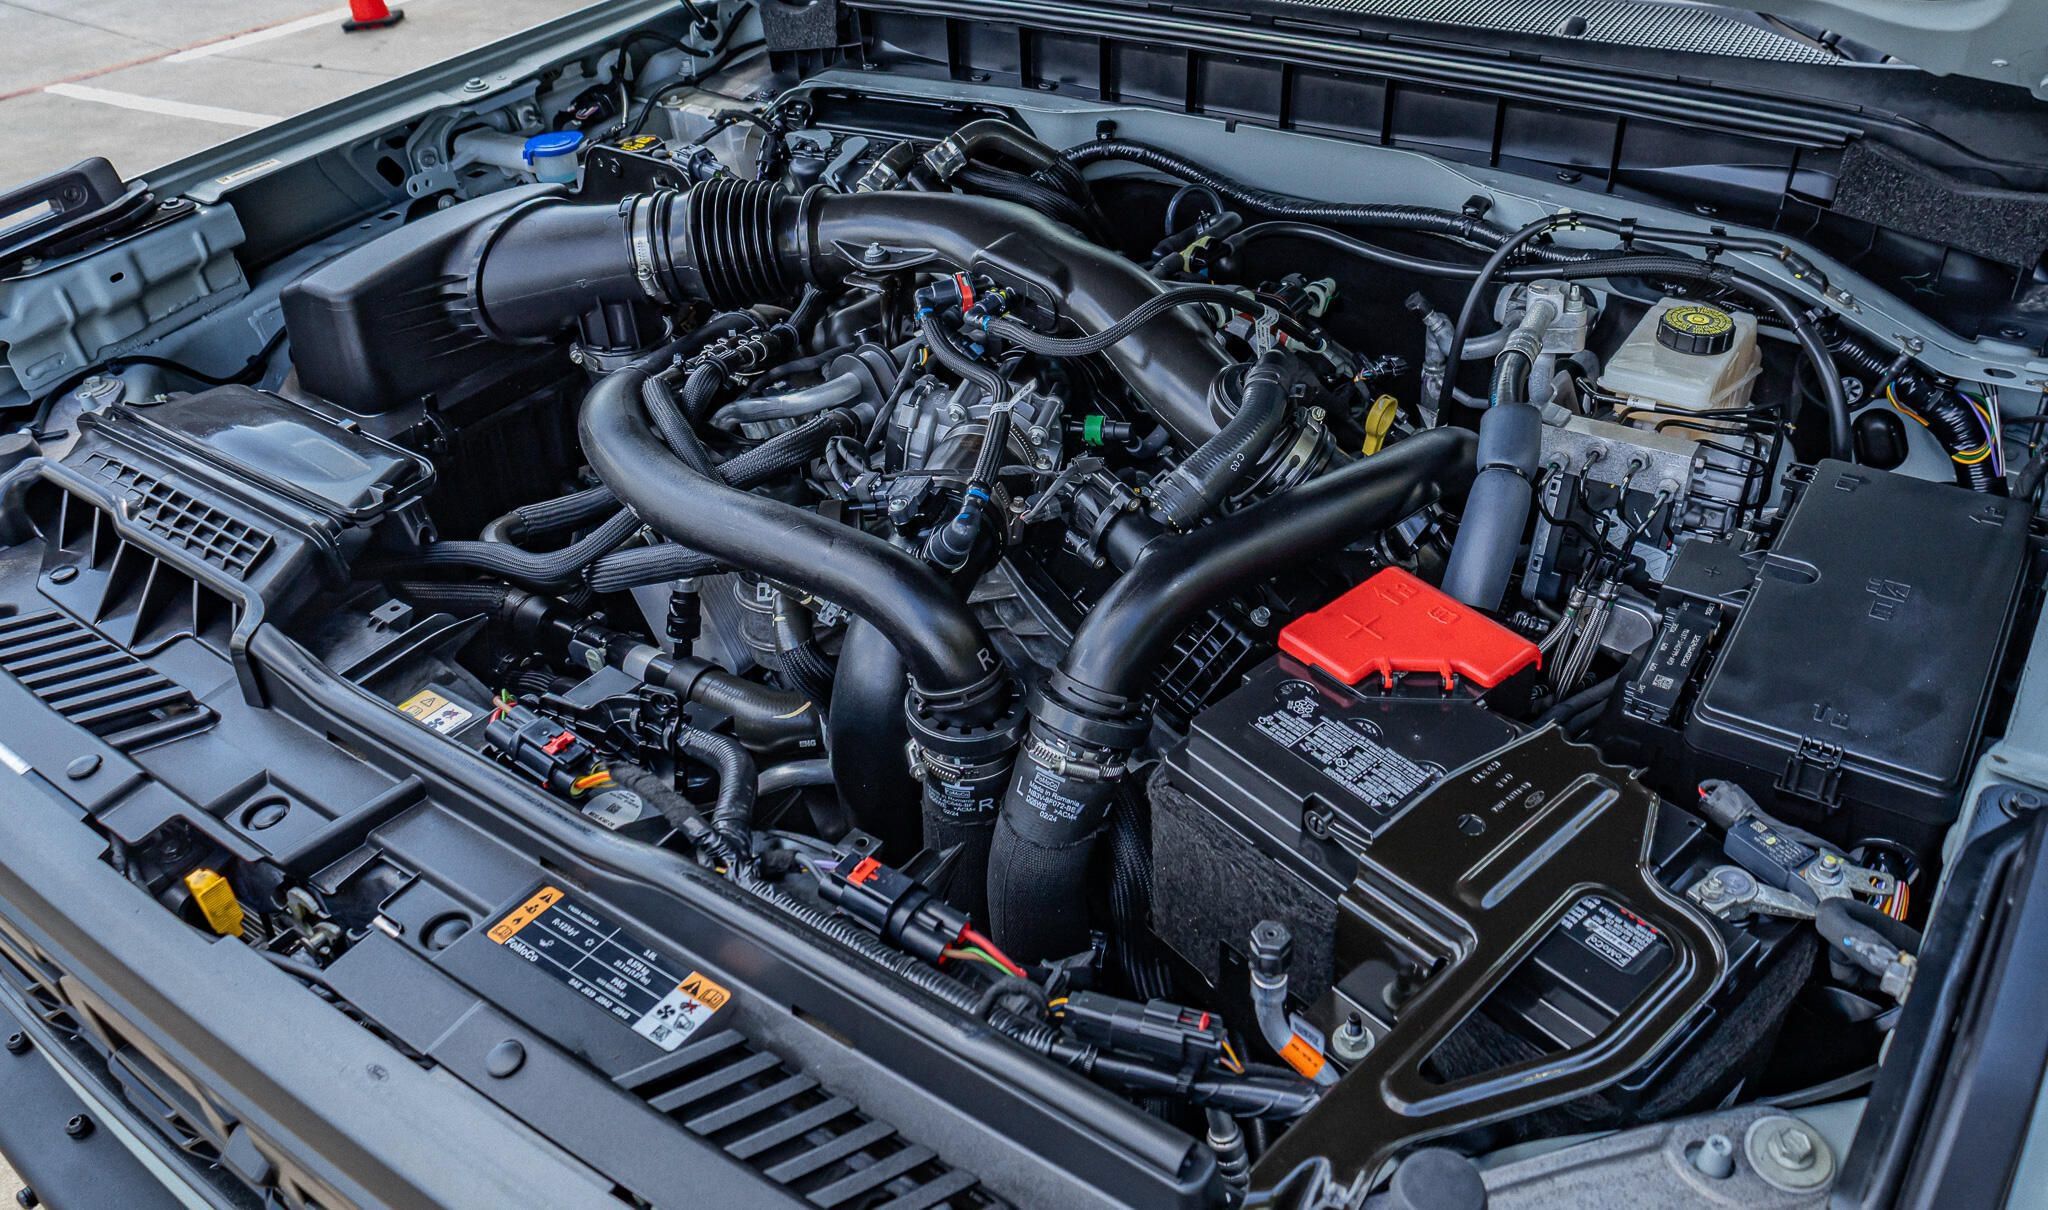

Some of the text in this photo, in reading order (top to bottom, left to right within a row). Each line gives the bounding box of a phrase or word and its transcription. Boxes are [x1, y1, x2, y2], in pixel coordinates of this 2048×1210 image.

[976, 647, 995, 672] R
[1016, 776, 1024, 797] L
[1029, 781, 1046, 795] Made
[1051, 788, 1080, 808] Romania
[978, 798, 994, 812] R
[1039, 810, 1058, 823] 02/24
[505, 937, 539, 962] FoMoCo
[1590, 936, 1628, 965] FoMoCo
